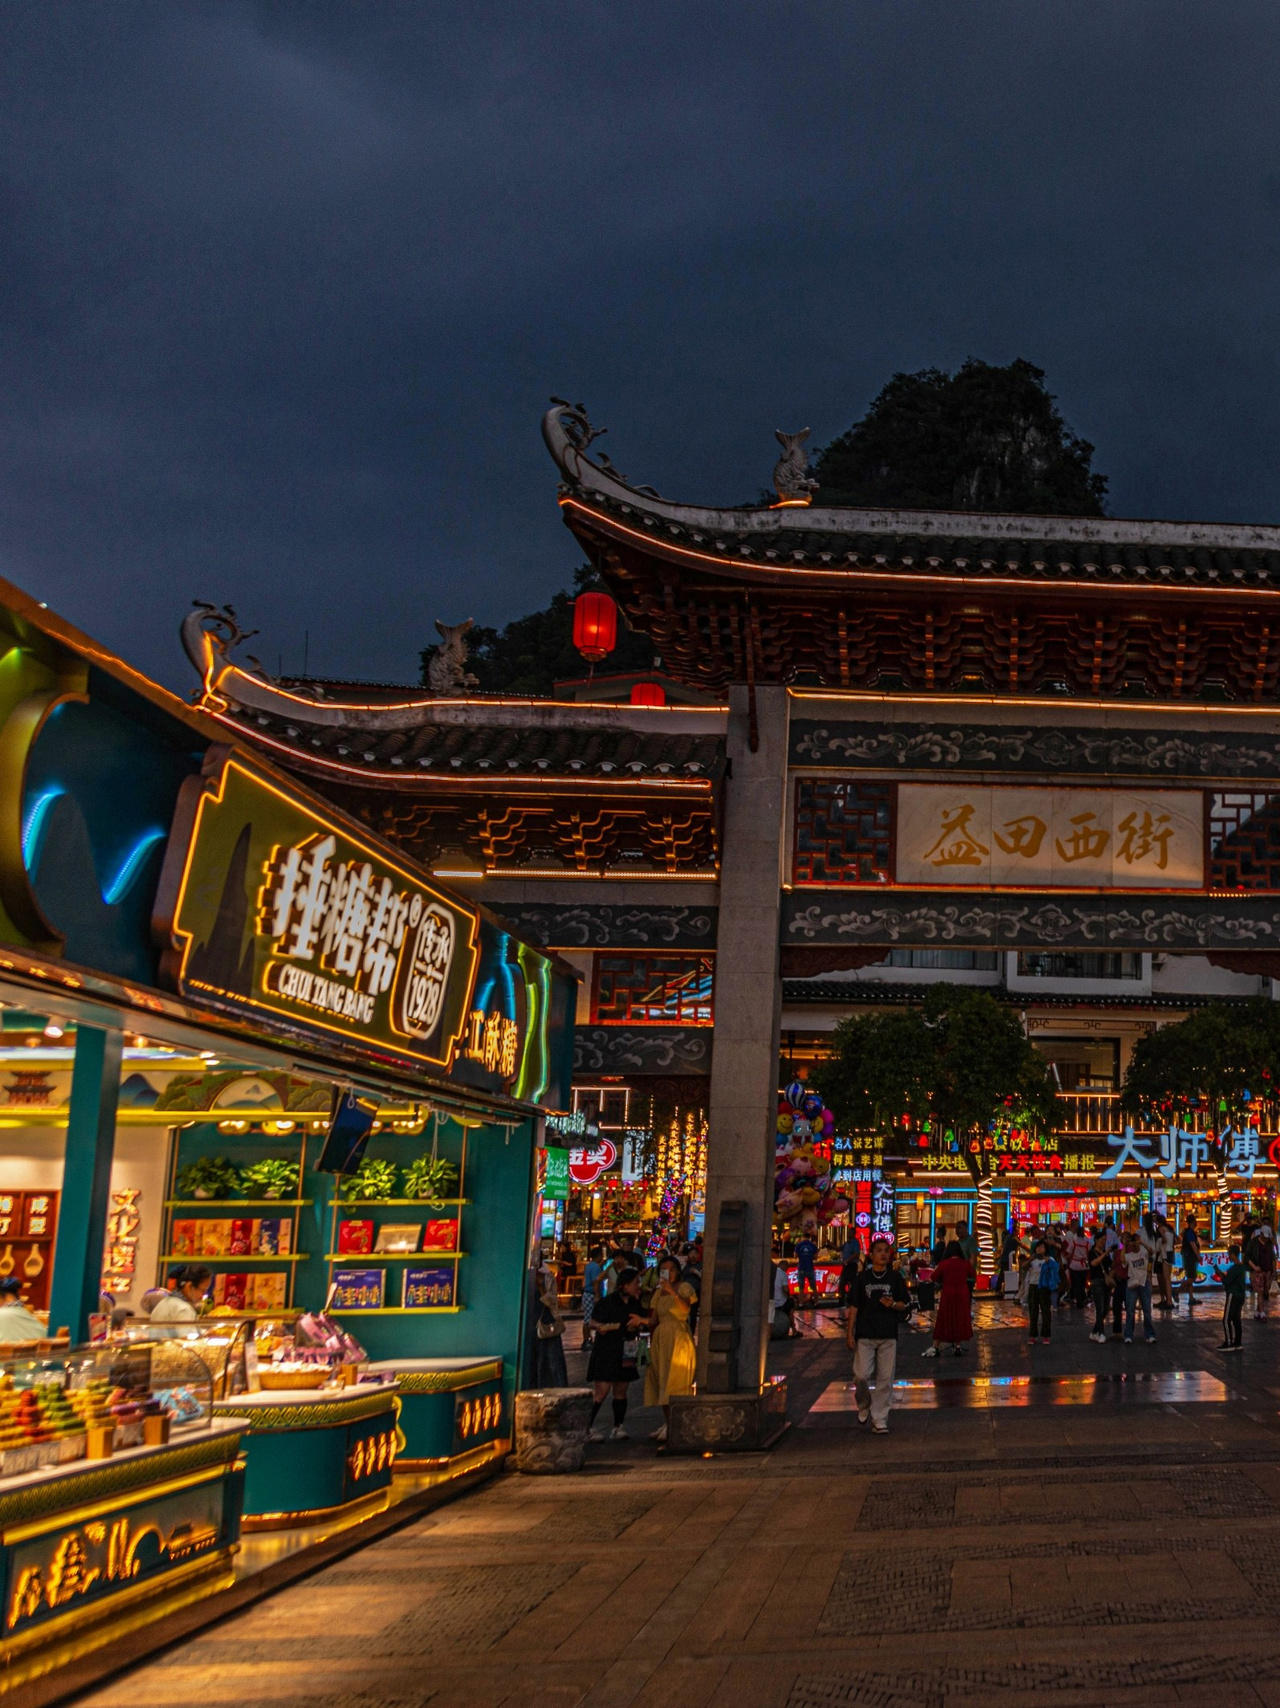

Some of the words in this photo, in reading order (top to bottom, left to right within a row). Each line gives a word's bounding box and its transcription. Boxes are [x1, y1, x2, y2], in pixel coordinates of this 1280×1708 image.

[923, 803, 1175, 870] 益田西街
[278, 963, 313, 1002] CHUI
[312, 973, 344, 1013] TANG
[344, 985, 376, 1025] BANG
[407, 976, 441, 1026] 1928
[1099, 1124, 1266, 1179] 大师傅
